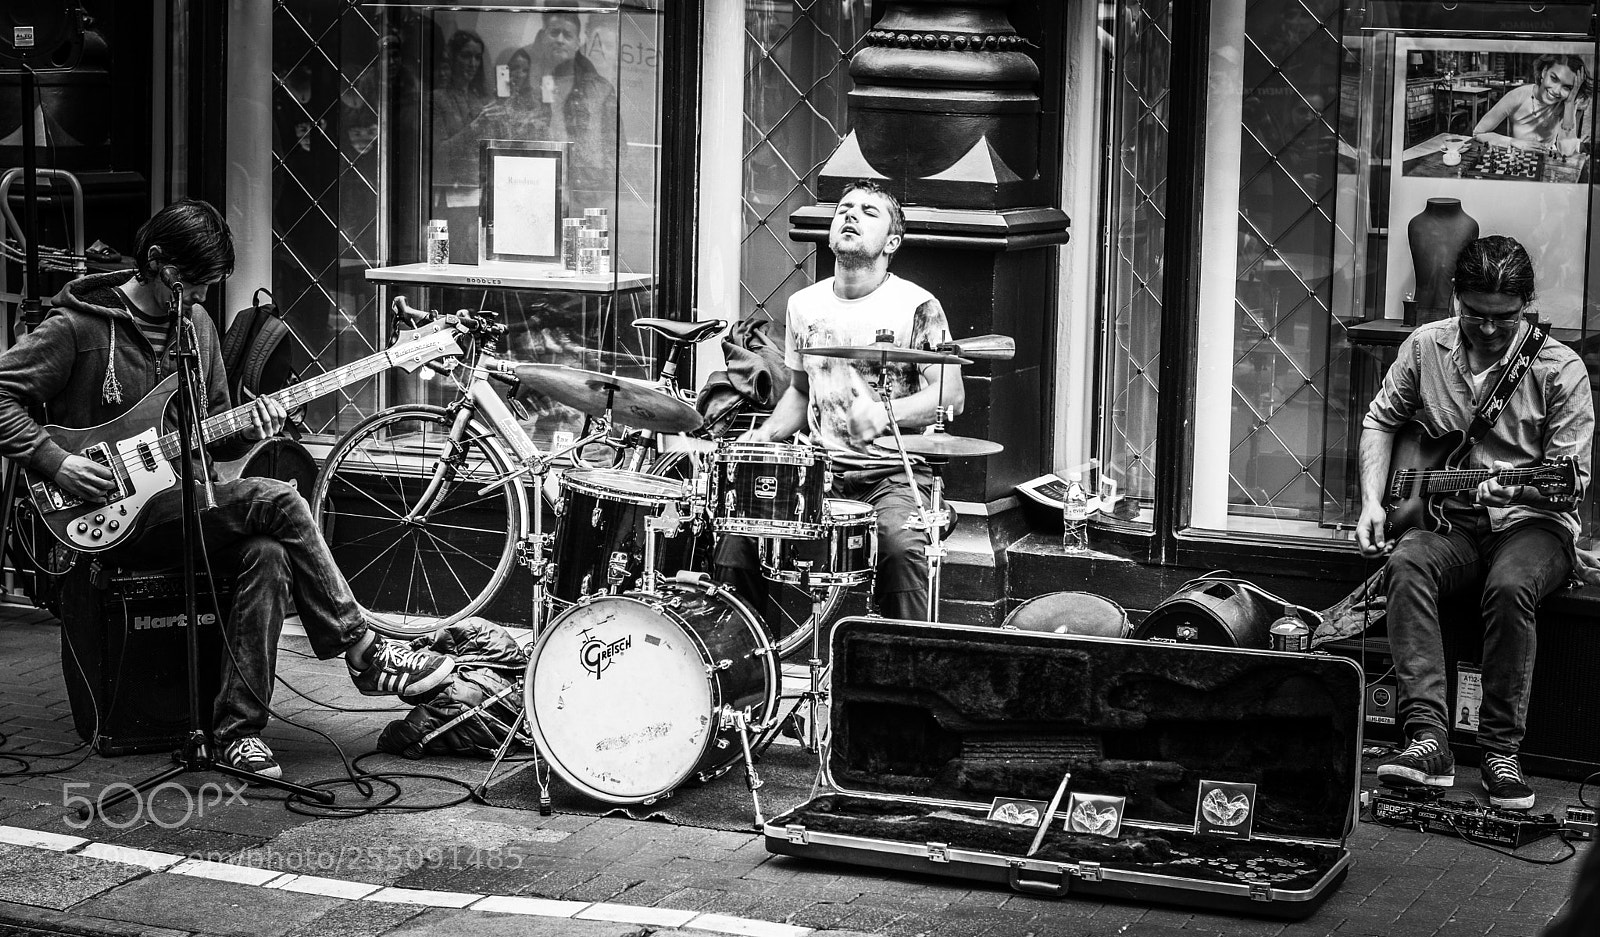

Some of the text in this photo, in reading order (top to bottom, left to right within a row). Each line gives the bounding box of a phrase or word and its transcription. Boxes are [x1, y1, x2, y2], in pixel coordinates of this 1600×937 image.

[466, 277, 502, 285] BOODLES
[1508, 352, 1530, 383] Fender
[1463, 675, 1482, 683] A132-
